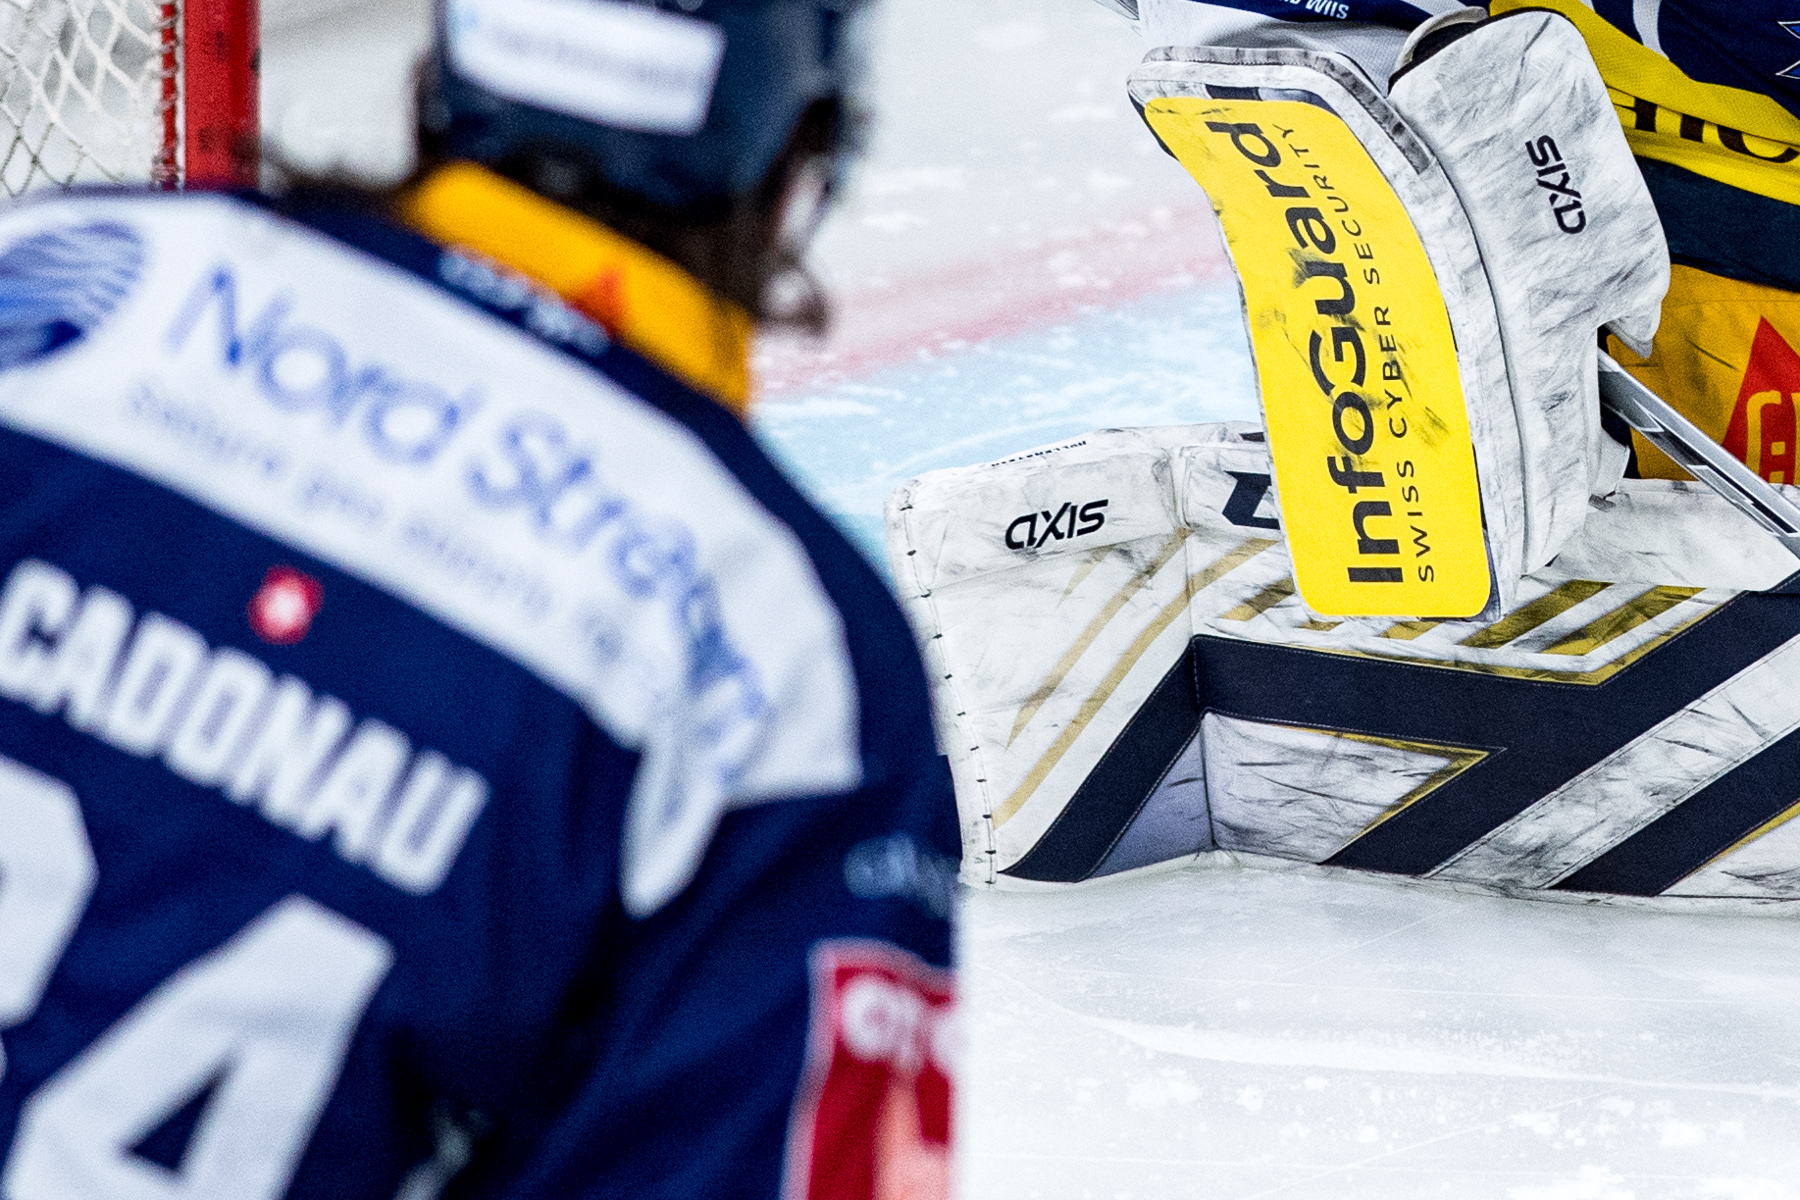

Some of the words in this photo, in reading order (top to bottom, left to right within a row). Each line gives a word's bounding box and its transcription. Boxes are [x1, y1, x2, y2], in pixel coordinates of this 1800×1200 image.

[1272, 123, 1381, 287] SECURITY
[163, 258, 489, 469] Nord
[1204, 120, 1404, 584] InfoGuard
[1373, 305, 1409, 439] CYBER
[1396, 460, 1435, 583] SWISS
[0, 558, 491, 898] CADONAU
